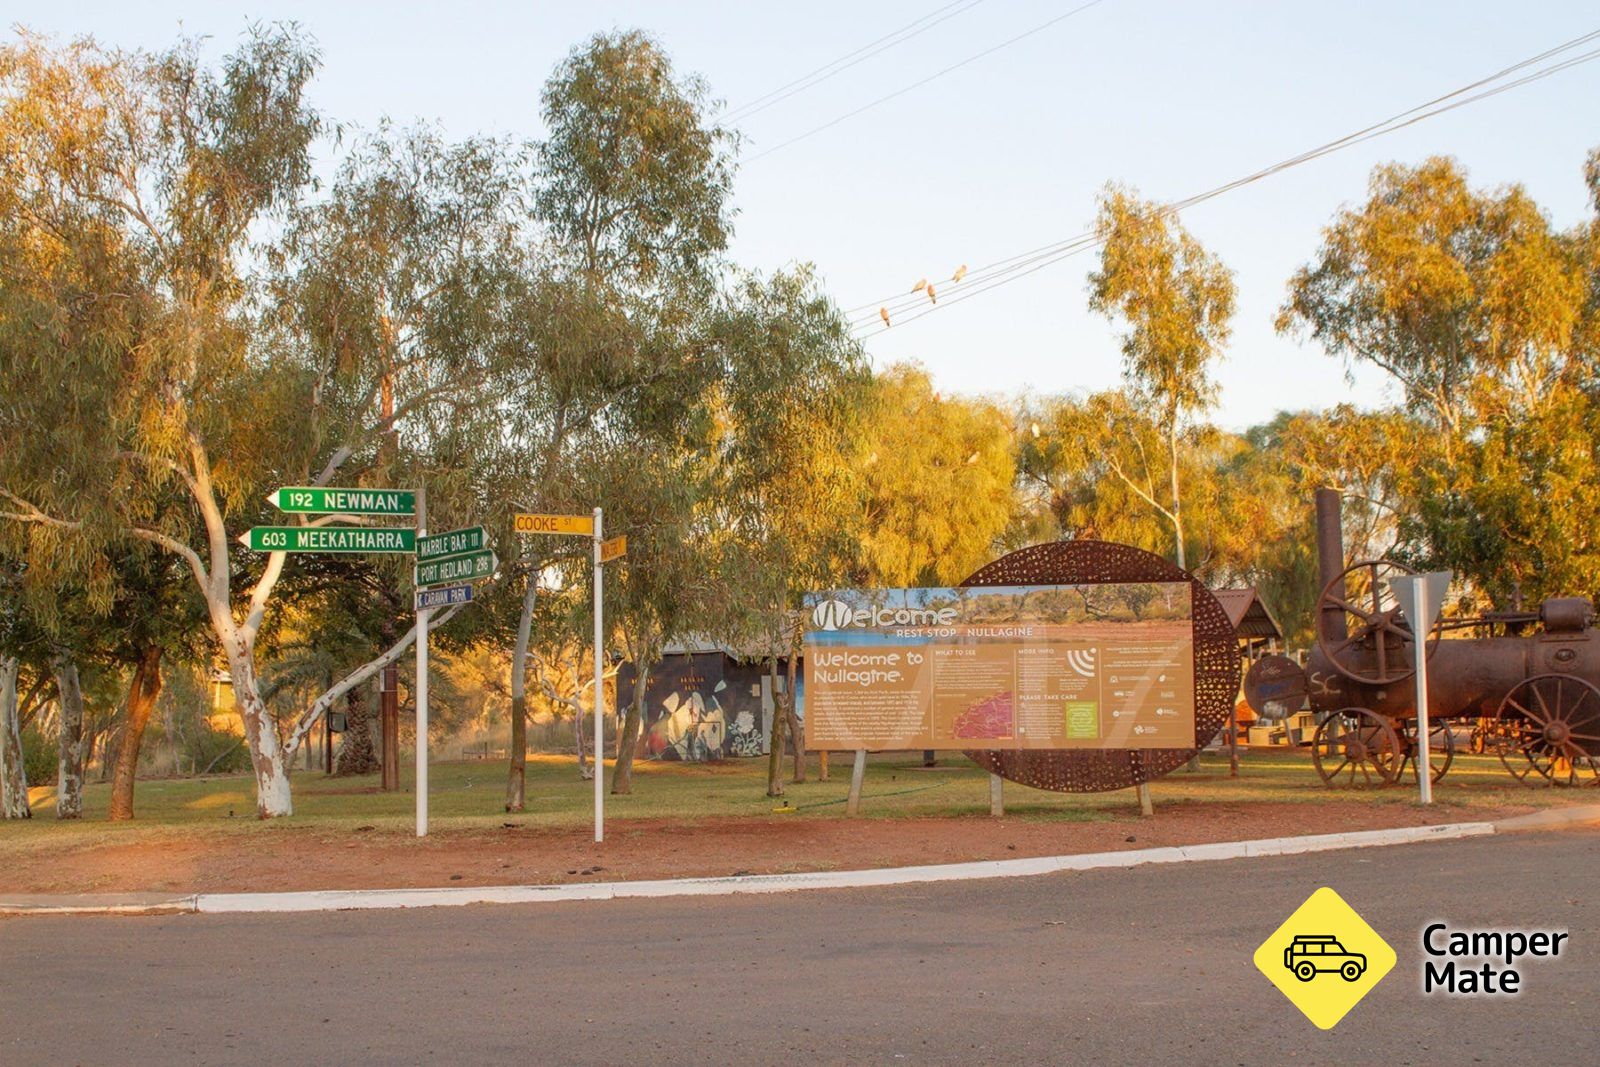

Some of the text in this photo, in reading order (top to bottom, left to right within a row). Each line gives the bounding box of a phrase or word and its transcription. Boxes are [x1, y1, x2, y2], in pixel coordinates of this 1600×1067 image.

[289, 492, 398, 510] 192 NEWMAN
[516, 516, 559, 531] COOKE
[262, 531, 404, 548] 603 MEEKATHARRA
[420, 537, 448, 557] MARBLE
[450, 533, 467, 552] BAR
[421, 565, 437, 582] PORT
[440, 558, 473, 579] HEDLAND
[450, 587, 467, 603] PARK
[813, 600, 958, 631] Welcome
[897, 627, 1033, 639] REST STOP NULLAGINE
[813, 651, 924, 667] Welcome to
[814, 669, 905, 687] Nullagine.
